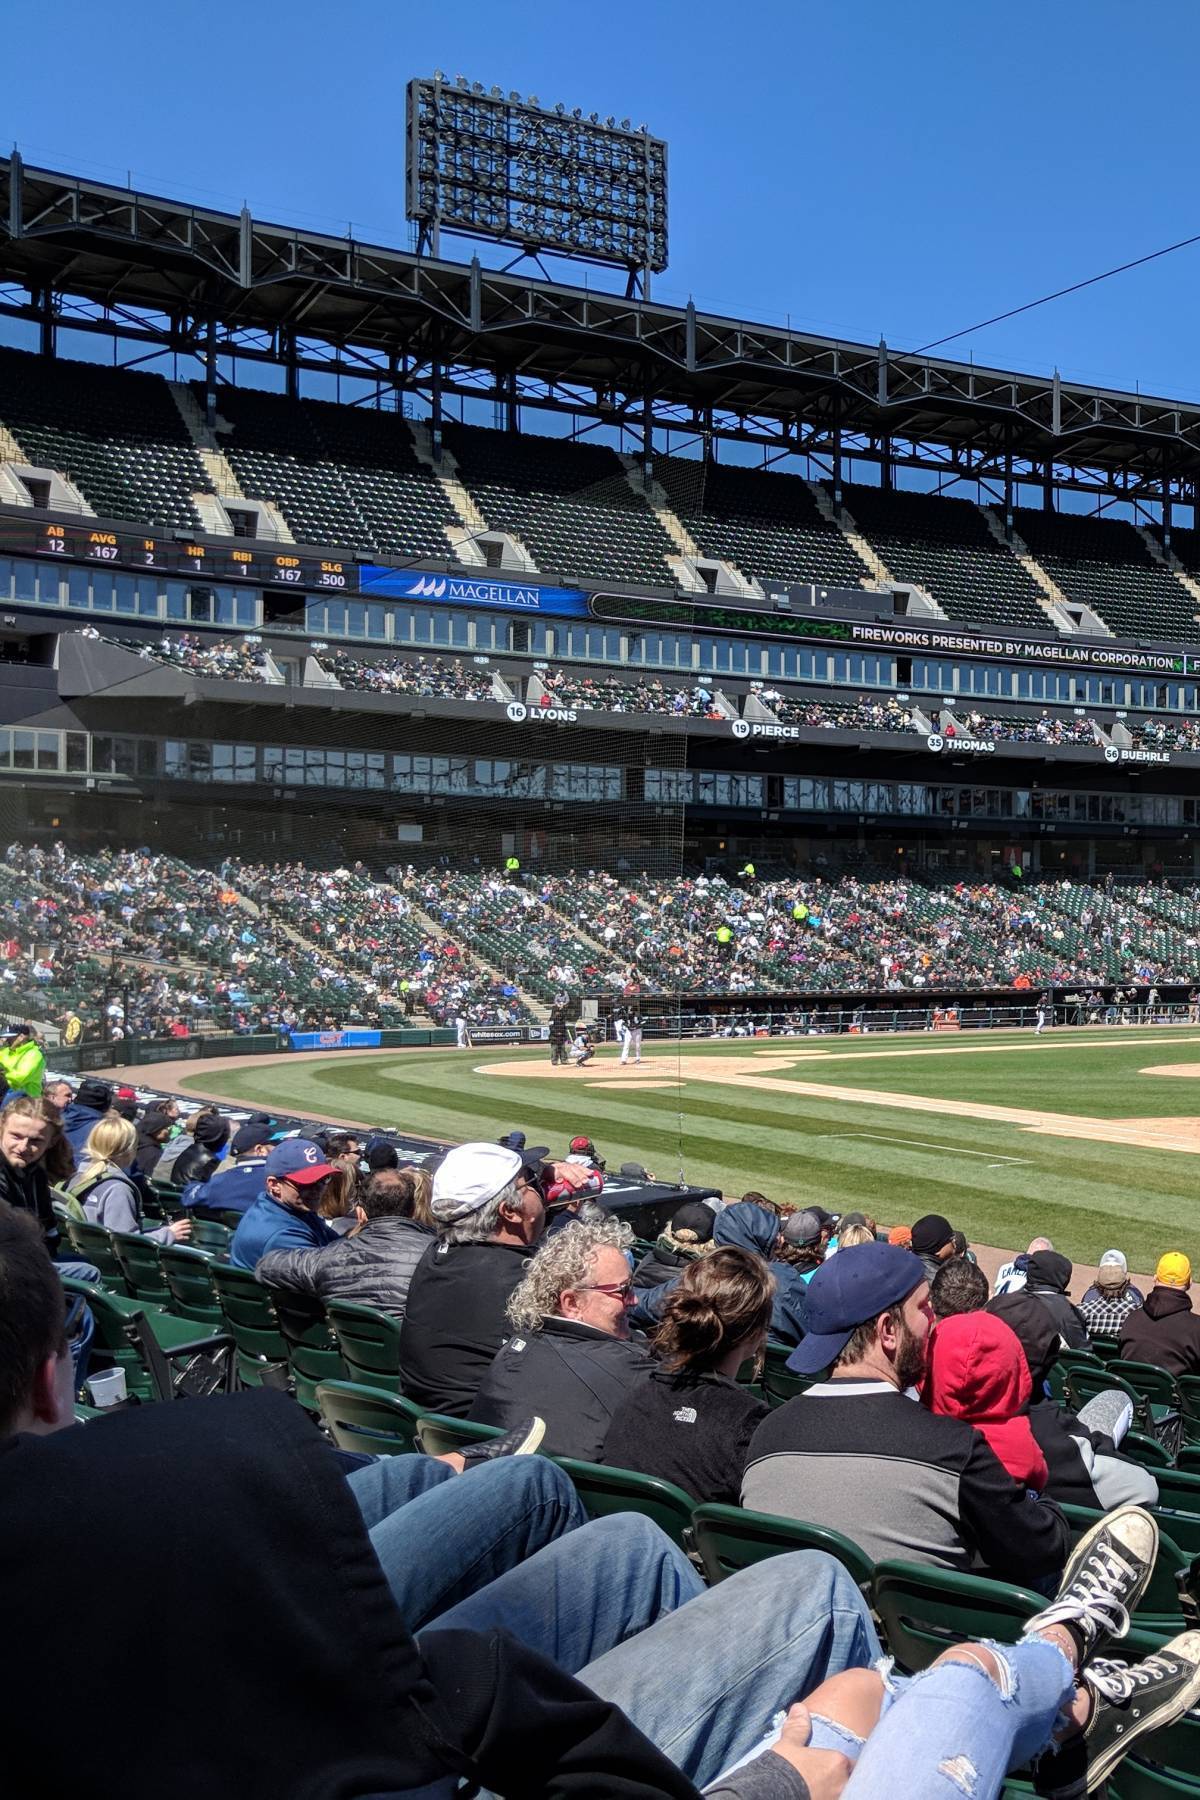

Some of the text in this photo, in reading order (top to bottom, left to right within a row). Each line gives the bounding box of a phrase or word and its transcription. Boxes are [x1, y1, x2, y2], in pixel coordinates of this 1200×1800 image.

[47, 526, 65, 537] AB
[90, 533, 117, 545] AVG
[49, 539, 65, 552] 12
[145, 540, 154, 551] H
[90, 546, 118, 559] .167
[187, 547, 205, 557] HR
[233, 551, 252, 562] RBI
[146, 553, 154, 565] 2
[194, 559, 201, 571] 1
[275, 556, 300, 567] OBP
[241, 564, 248, 576] 1
[321, 562, 342, 573] SLG
[274, 569, 301, 582] .167
[318, 574, 346, 587] .500
[450, 583, 539, 605] MAGELLAN
[852, 626, 1174, 669] FIREWORKS PRESENTED BY MAGELLAN CORPORATION
[511, 705, 577, 722] 16 LYONS
[736, 723, 799, 737] 19 PIERCE
[929, 737, 995, 752] 35 THOMAS
[1106, 748, 1170, 762] 56 BUEHRLE
